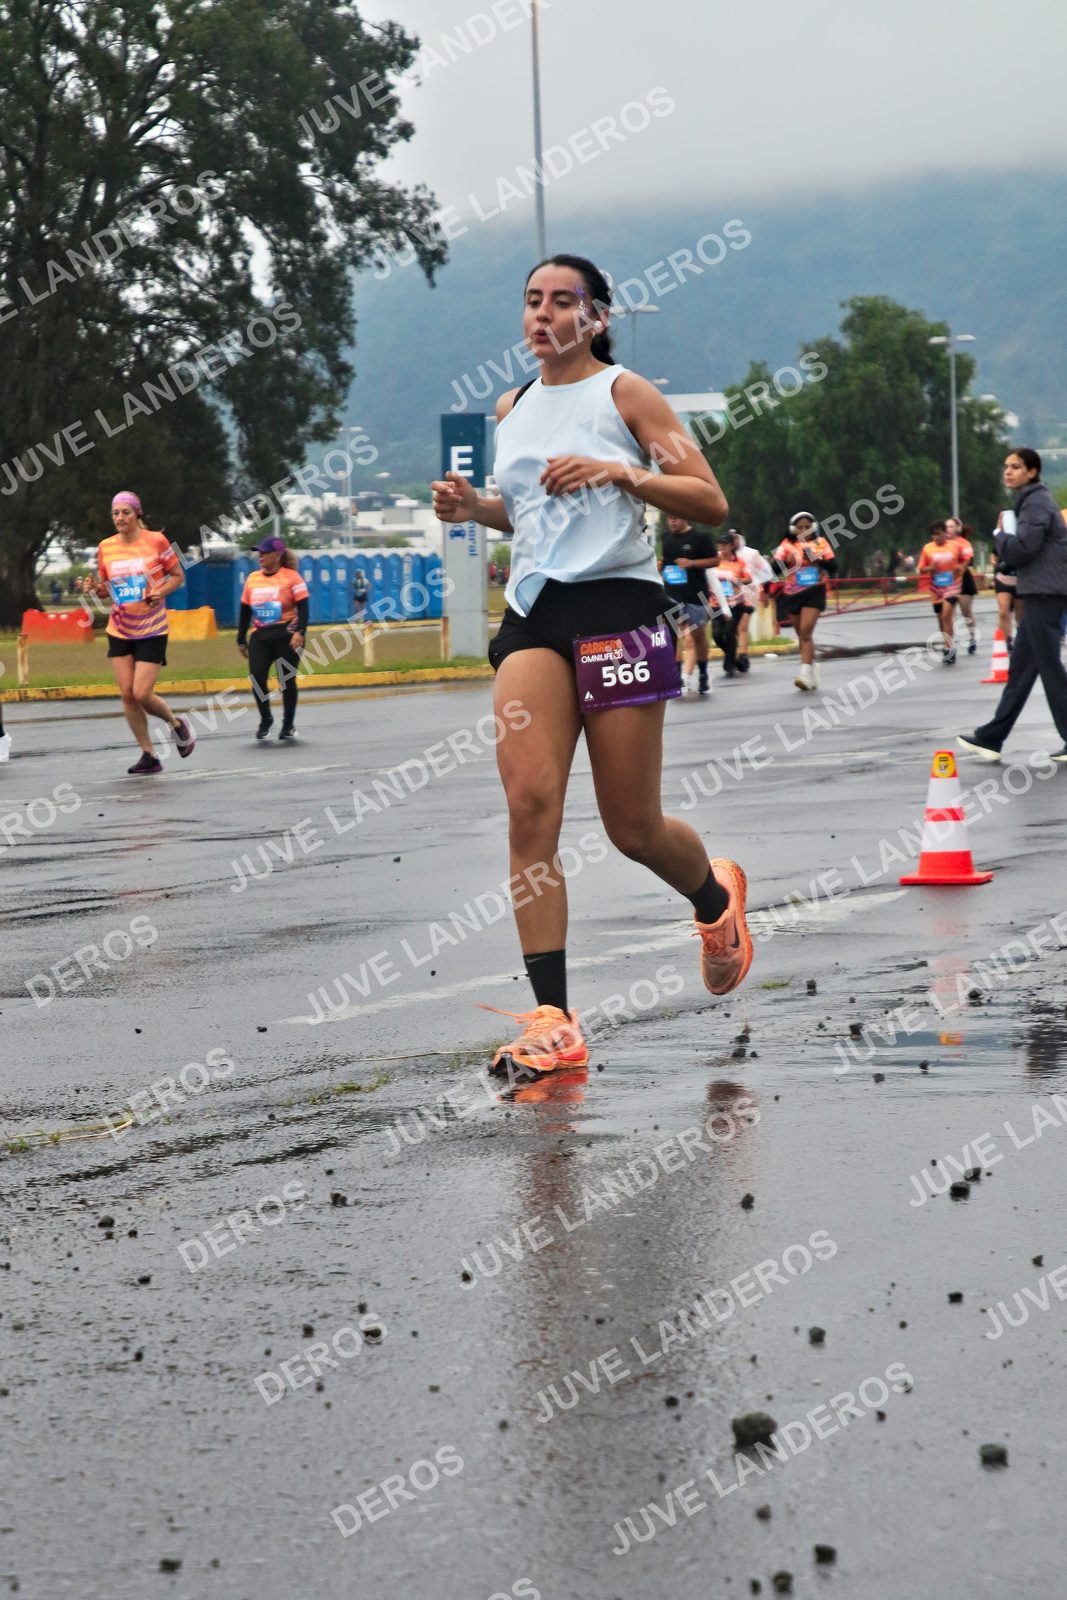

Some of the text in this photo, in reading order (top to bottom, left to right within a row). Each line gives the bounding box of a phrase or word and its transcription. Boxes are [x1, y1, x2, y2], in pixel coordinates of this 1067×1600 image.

[450, 445, 474, 477] E
[468, 520, 479, 556] neral
[581, 652, 614, 663] OMNILIFE
[602, 661, 650, 687] 566
